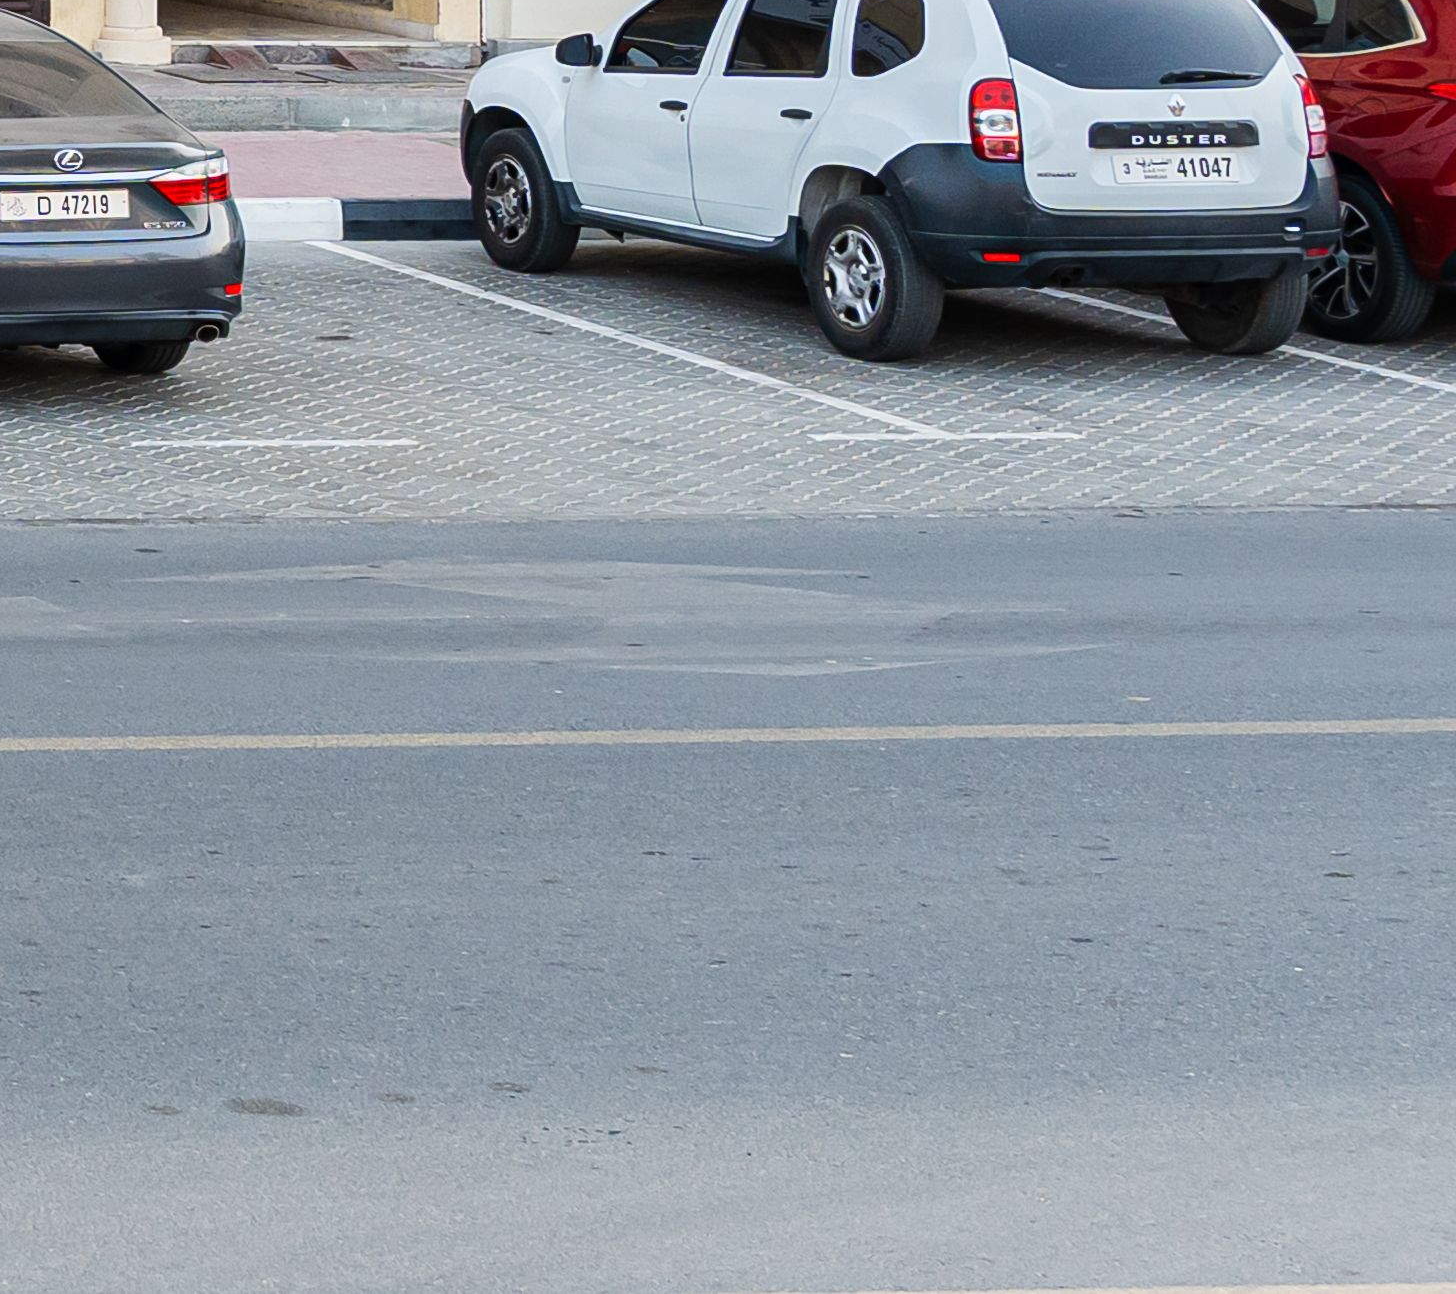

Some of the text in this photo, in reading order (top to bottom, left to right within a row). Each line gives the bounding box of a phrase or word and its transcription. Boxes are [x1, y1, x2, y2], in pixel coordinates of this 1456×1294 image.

[1131, 134, 1227, 146] DUSTER
[1122, 163, 1131, 175] 3
[1177, 157, 1232, 178] 41047
[37, 196, 51, 216] D
[61, 194, 109, 215] 47219
